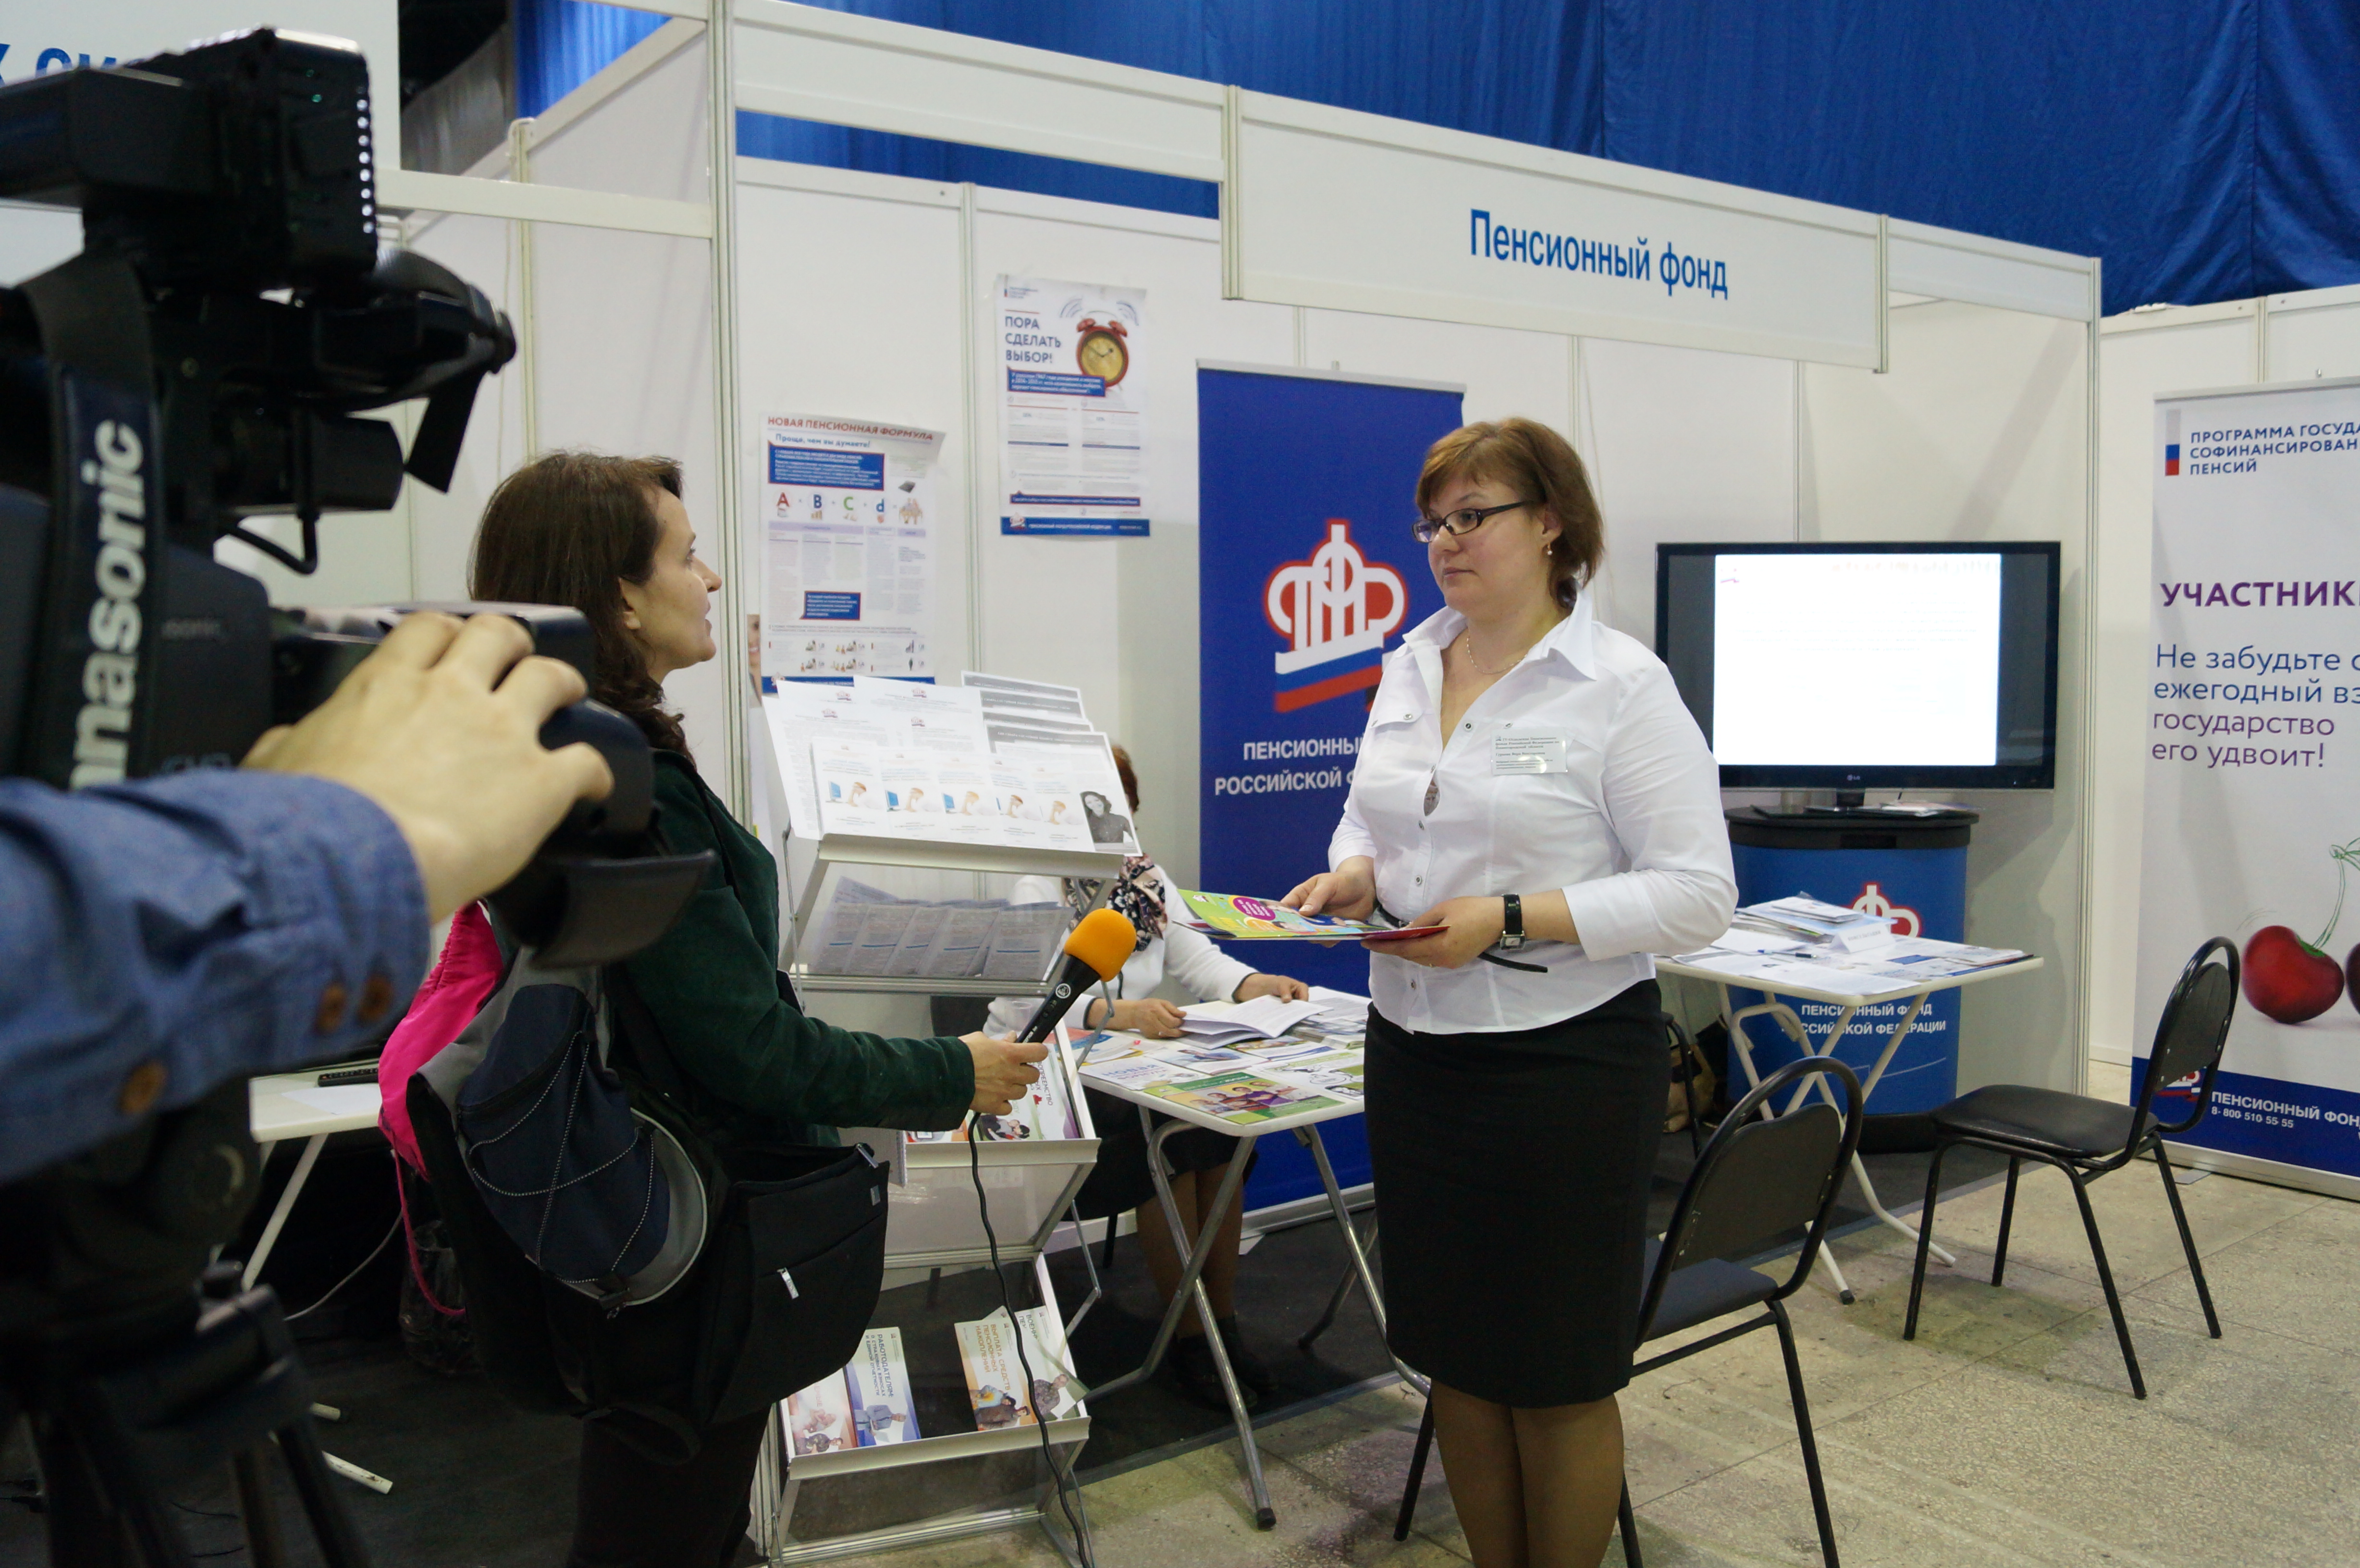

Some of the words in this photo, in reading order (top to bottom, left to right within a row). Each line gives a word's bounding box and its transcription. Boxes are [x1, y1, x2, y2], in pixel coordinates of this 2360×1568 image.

[1471, 208, 1650, 281] Пенсионный
[1660, 242, 1728, 300] фонд
[1005, 316, 1040, 330] ПОРА
[1005, 333, 1061, 348] СДЕЛАТЬ
[1006, 350, 1053, 363] ВЫБОР!
[768, 416, 803, 427] НОВАЯ
[806, 420, 877, 434] ПЕНСИОННАЯ
[880, 427, 934, 440] ФОРМУЛА
[775, 433, 806, 443] Проще,
[2190, 426, 2295, 444] ПРОГРАММА
[2189, 438, 2360, 459] СОФИНАНСИРОВАН
[2190, 458, 2257, 476] ПЕНСИЙ
[876, 499, 885, 513] d
[69, 419, 146, 790] nasonic
[2159, 580, 2360, 607] УЧАСТНИК
[2156, 644, 2196, 668] Не
[2205, 644, 2341, 676] забудьте
[2154, 678, 2322, 705] ежегодный
[2153, 713, 2335, 739] государство
[2151, 743, 2198, 761] его
[2207, 742, 2324, 769] удвоит!
[1215, 766, 1342, 796] РОССИЙСКОЙ
[1802, 1003, 1894, 1016] ПЕНСИННЫЙ
[2211, 1091, 2320, 1120] ПЕНСИОННЫЙ
[2324, 1111, 2360, 1130] ФОН
[2281, 1118, 2294, 1128] 55
[975, 1325, 991, 1373] НАКОПЛЕНИЙ
[983, 1324, 998, 1372] ПЕНСИОННЫХ
[990, 1323, 1003, 1357] ВЫПЛАТА
[998, 1359, 1011, 1390] СРЕДСТВ
[877, 1334, 894, 1398] РАБОТОДАТЕЛЯМ:
